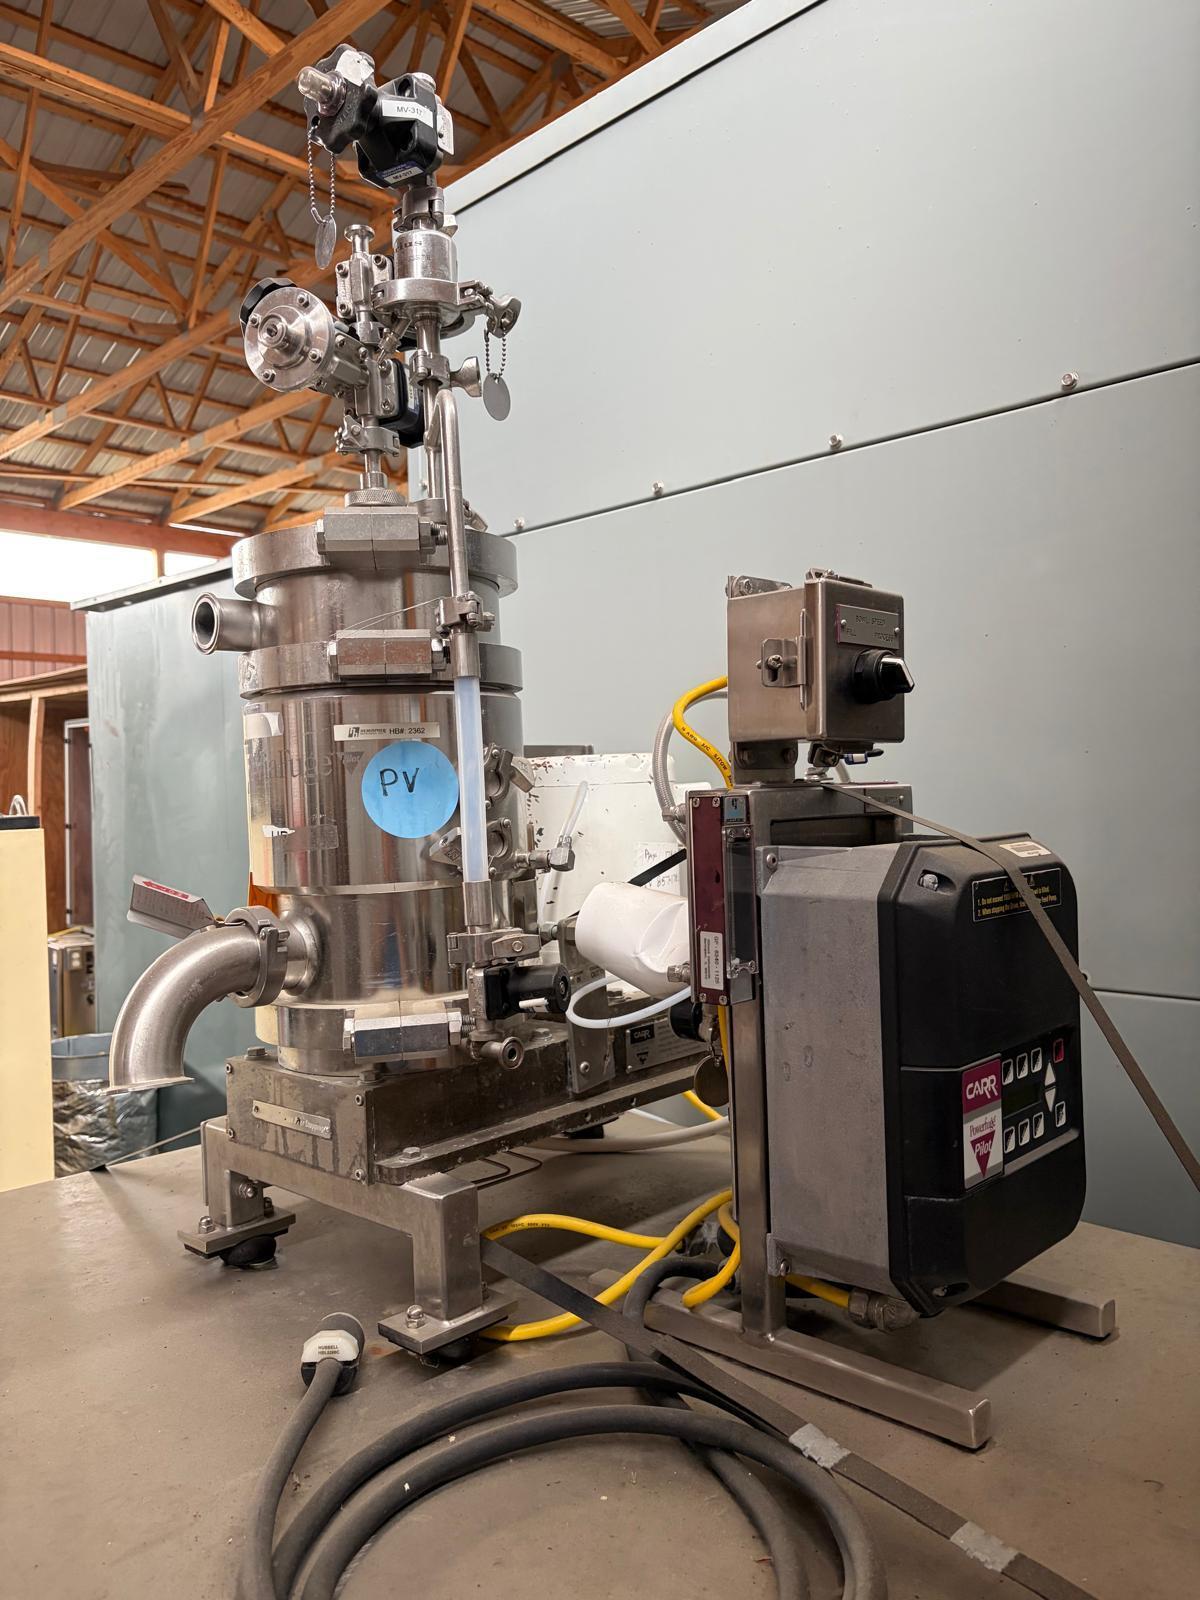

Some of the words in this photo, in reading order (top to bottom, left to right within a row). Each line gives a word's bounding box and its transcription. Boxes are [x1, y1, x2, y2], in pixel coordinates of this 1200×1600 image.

[408, 727, 426, 735] 2362
[379, 767, 420, 797] PV
[966, 1075, 998, 1099] CARR
[969, 1115, 997, 1138] Powerfuge
[974, 1139, 992, 1156] Pilot
